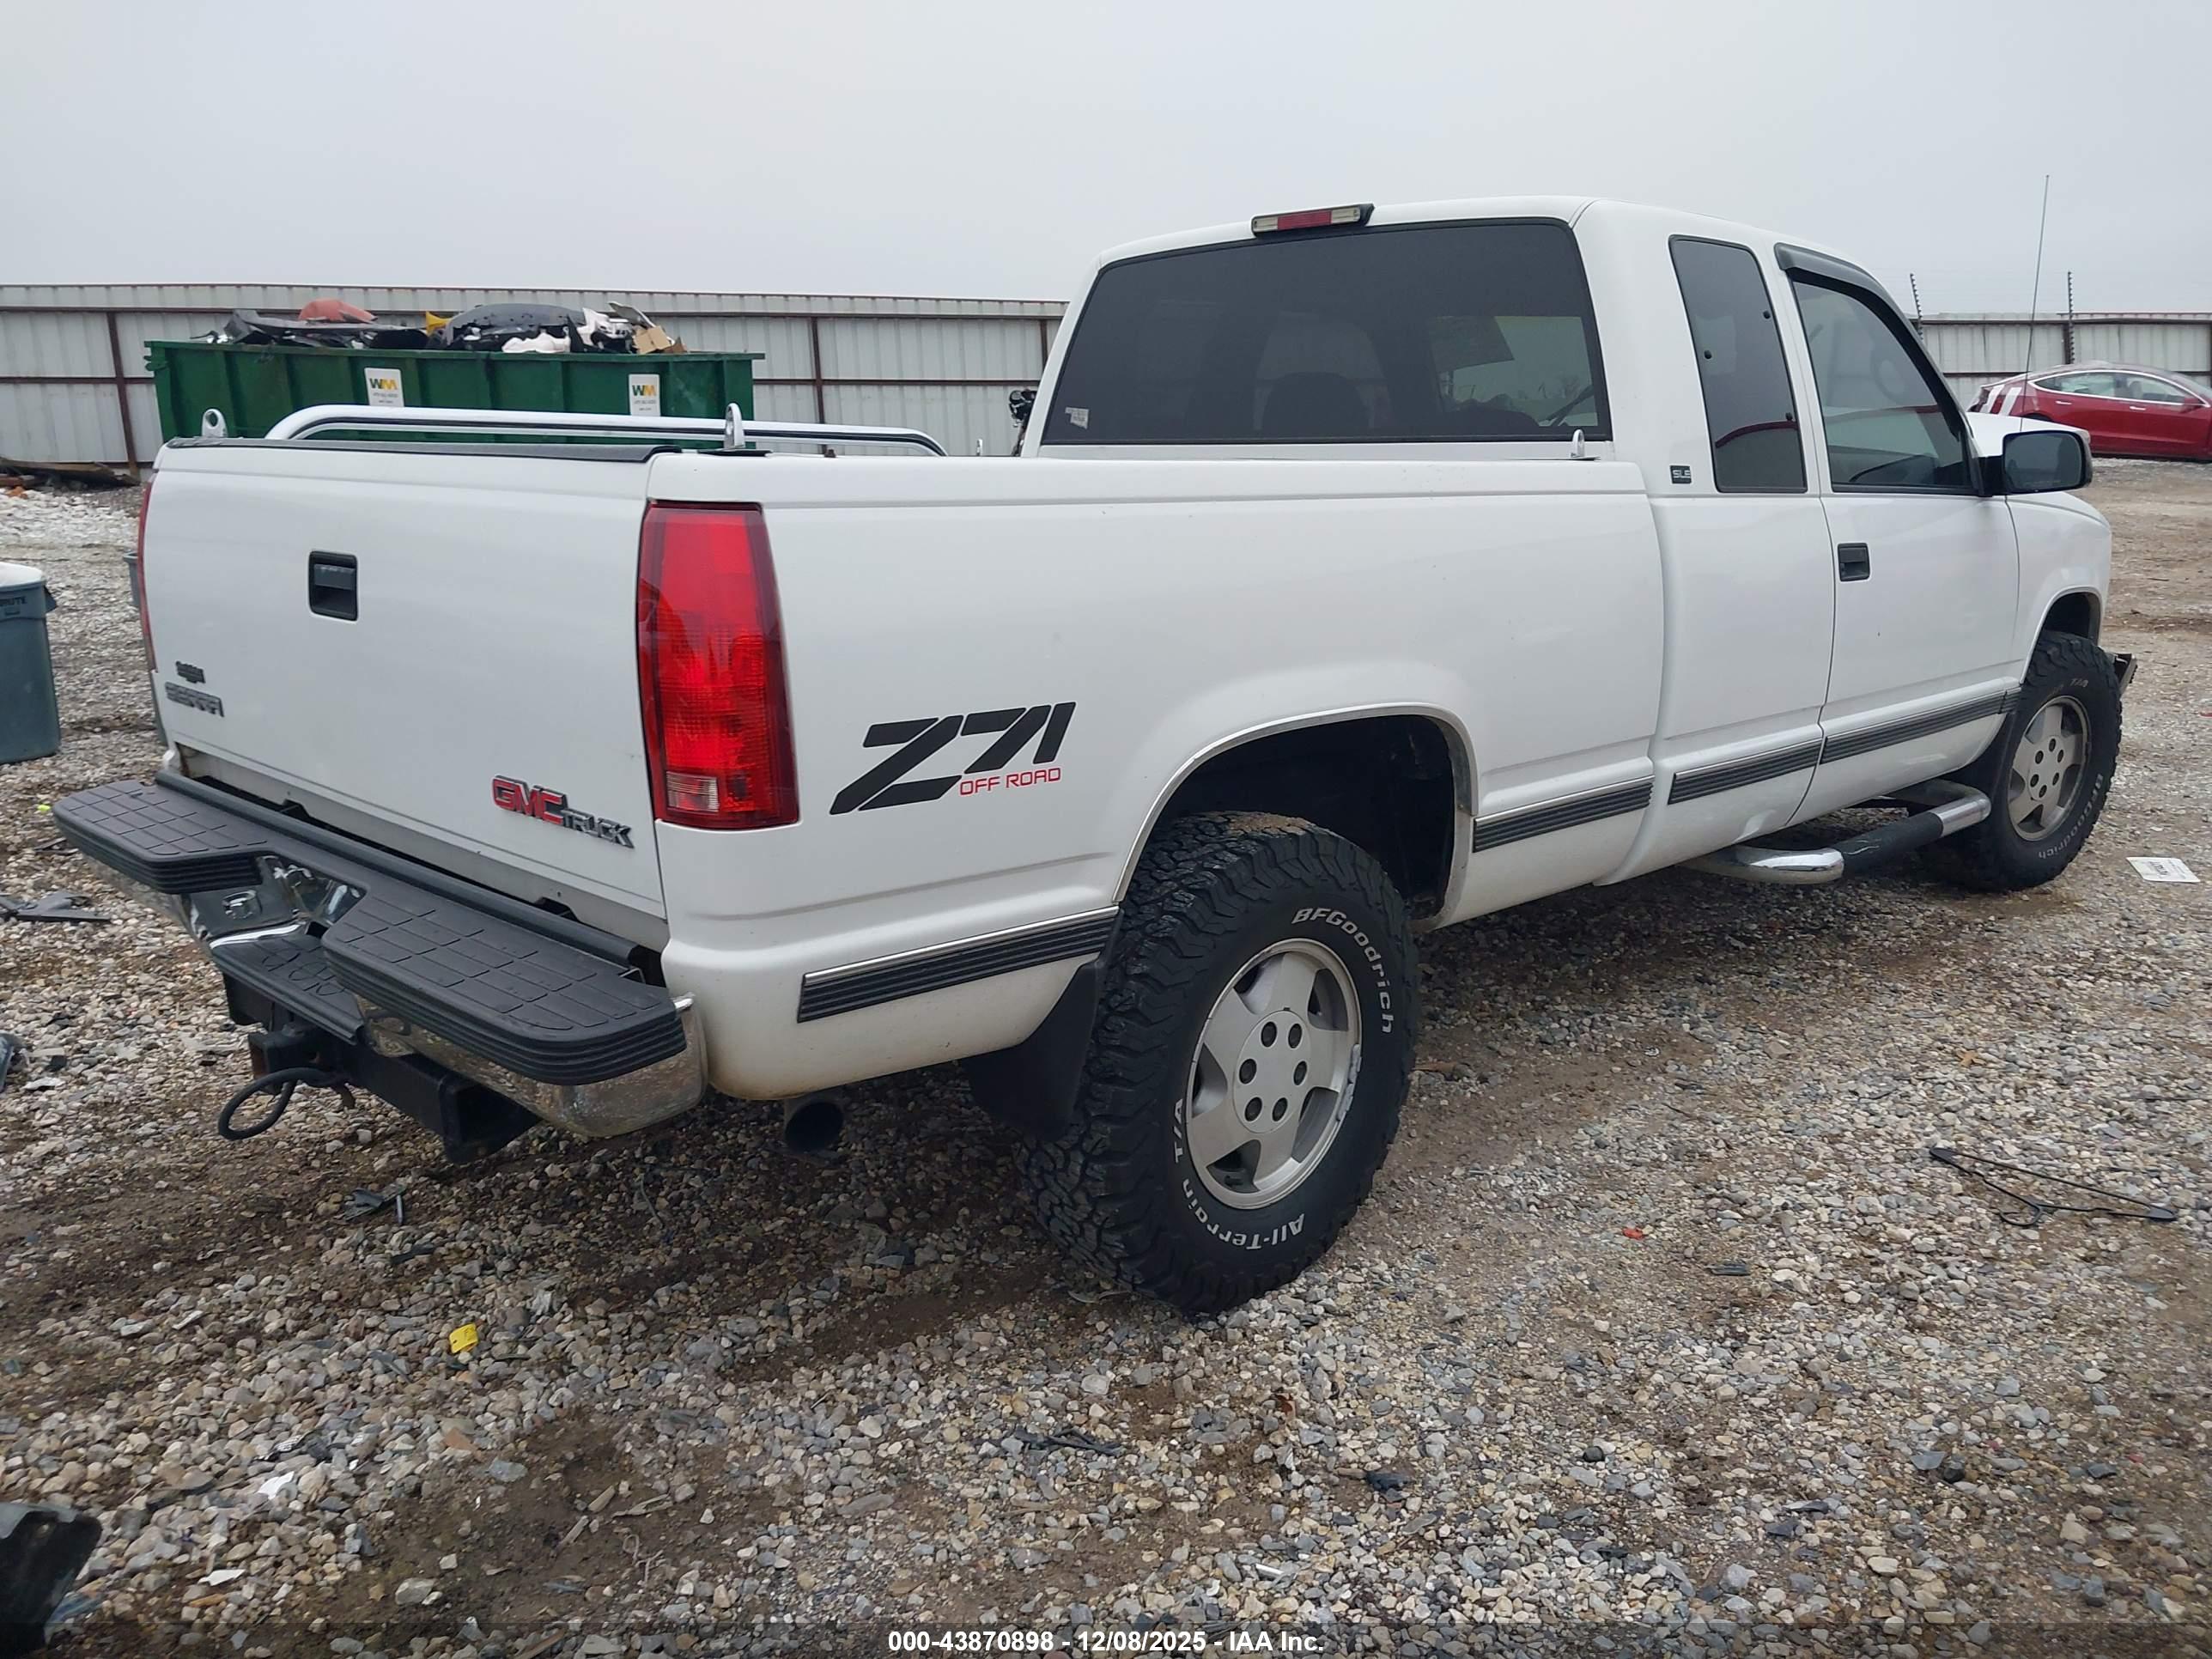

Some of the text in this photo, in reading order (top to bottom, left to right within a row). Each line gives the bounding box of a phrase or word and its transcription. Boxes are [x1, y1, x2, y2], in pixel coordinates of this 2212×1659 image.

[369, 378, 398, 390] WM
[632, 385, 656, 396] WM
[830, 702, 1077, 816] Z71
[959, 768, 1061, 796] OFF ROAD
[492, 775, 635, 848] GMC TRUCK
[1291, 908, 1395, 1034] BFGoodrich
[1174, 1098, 1304, 1249] All-Terrain T/A
